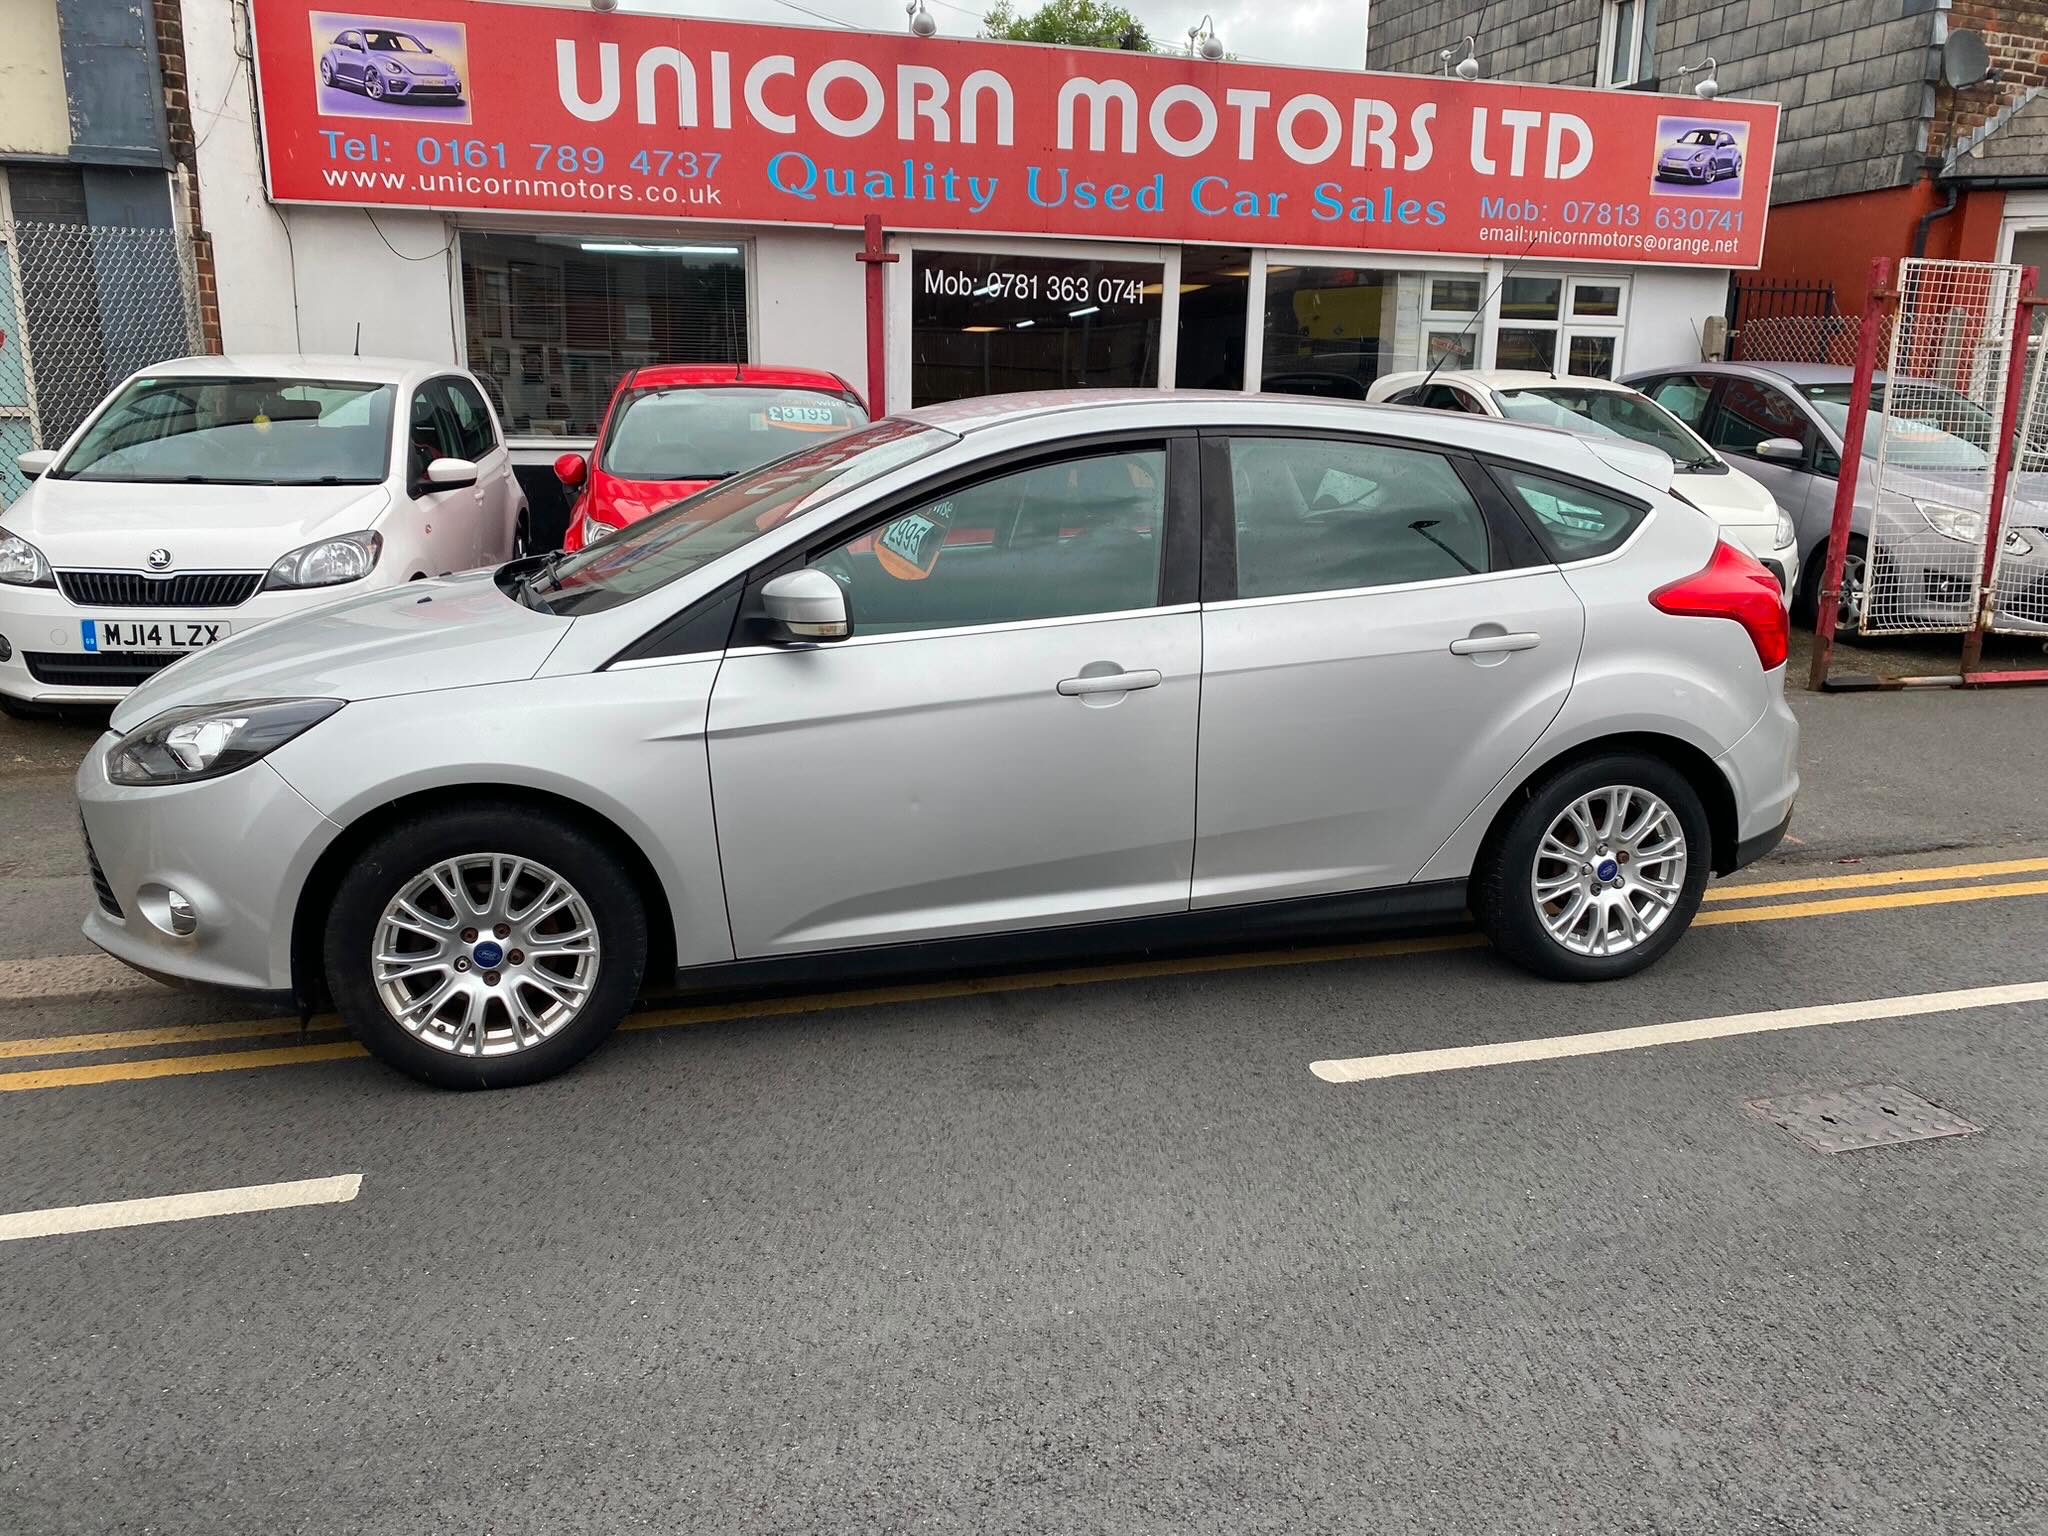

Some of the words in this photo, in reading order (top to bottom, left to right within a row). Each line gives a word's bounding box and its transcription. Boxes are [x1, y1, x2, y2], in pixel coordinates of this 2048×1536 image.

[557, 39, 1014, 146] UNICORN
[1056, 77, 1437, 172] MOTORS
[1470, 107, 1594, 180] LTD
[319, 129, 391, 163] Tel:
[416, 136, 506, 169] 0161
[529, 143, 605, 174] 789
[629, 149, 722, 178] 4737
[321, 169, 722, 205] www.unicornmotors.co.uk
[766, 150, 999, 214] Quality
[1026, 165, 1165, 214] Used
[1189, 175, 1288, 218] Car
[1311, 181, 1447, 226] Sales
[1480, 195, 1548, 222] Mob:
[1562, 200, 1641, 227] 07813
[1654, 207, 1744, 232] 630741
[924, 268, 978, 297] Mob:
[986, 272, 1039, 300] 0781
[1046, 275, 1089, 302] 363
[1098, 278, 1145, 304] 0741
[104, 623, 162, 647] MJ14
[169, 624, 220, 647] LZX
